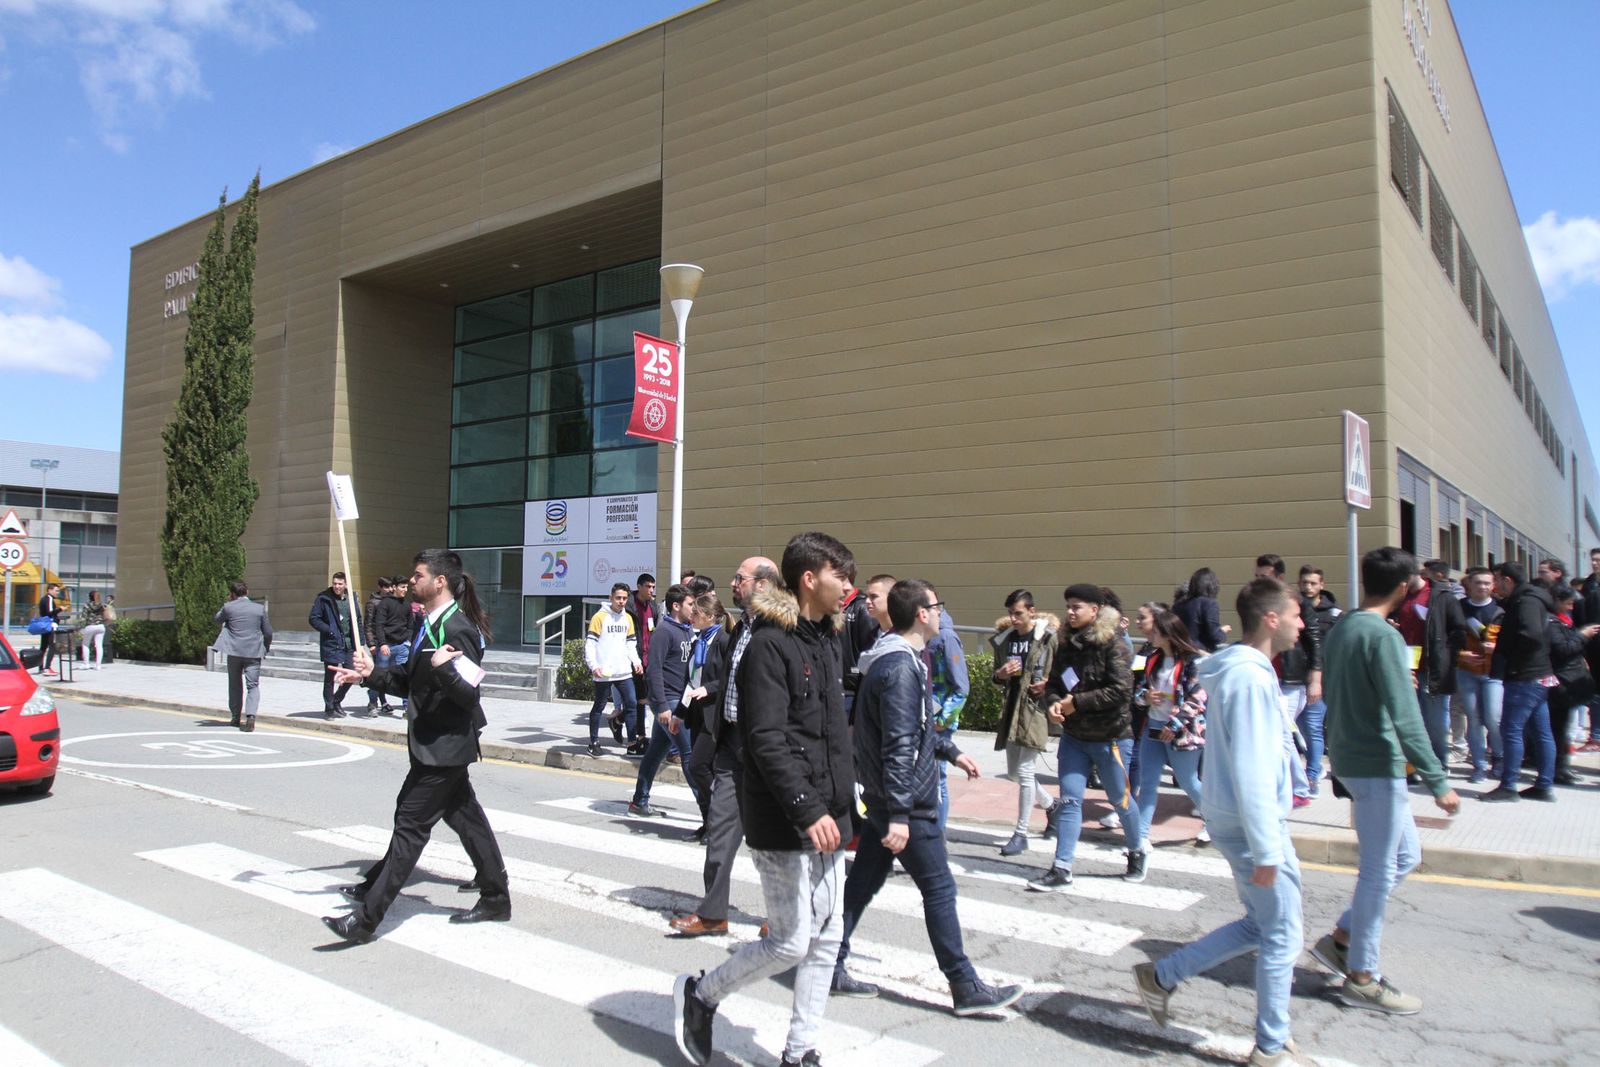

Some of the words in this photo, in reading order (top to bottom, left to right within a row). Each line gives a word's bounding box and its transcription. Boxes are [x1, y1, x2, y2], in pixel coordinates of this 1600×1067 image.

[164, 262, 200, 290] EDIFIC
[163, 293, 196, 318] PAUL
[642, 343, 673, 377] 25
[643, 373, 656, 382] 1993
[659, 377, 671, 387] 2018
[606, 502, 639, 514] FORMACIÓN
[606, 513, 638, 523] PROFESIONAL
[1, 549, 20, 559] 30
[540, 548, 568, 579] 25
[140, 739, 282, 758] 30
